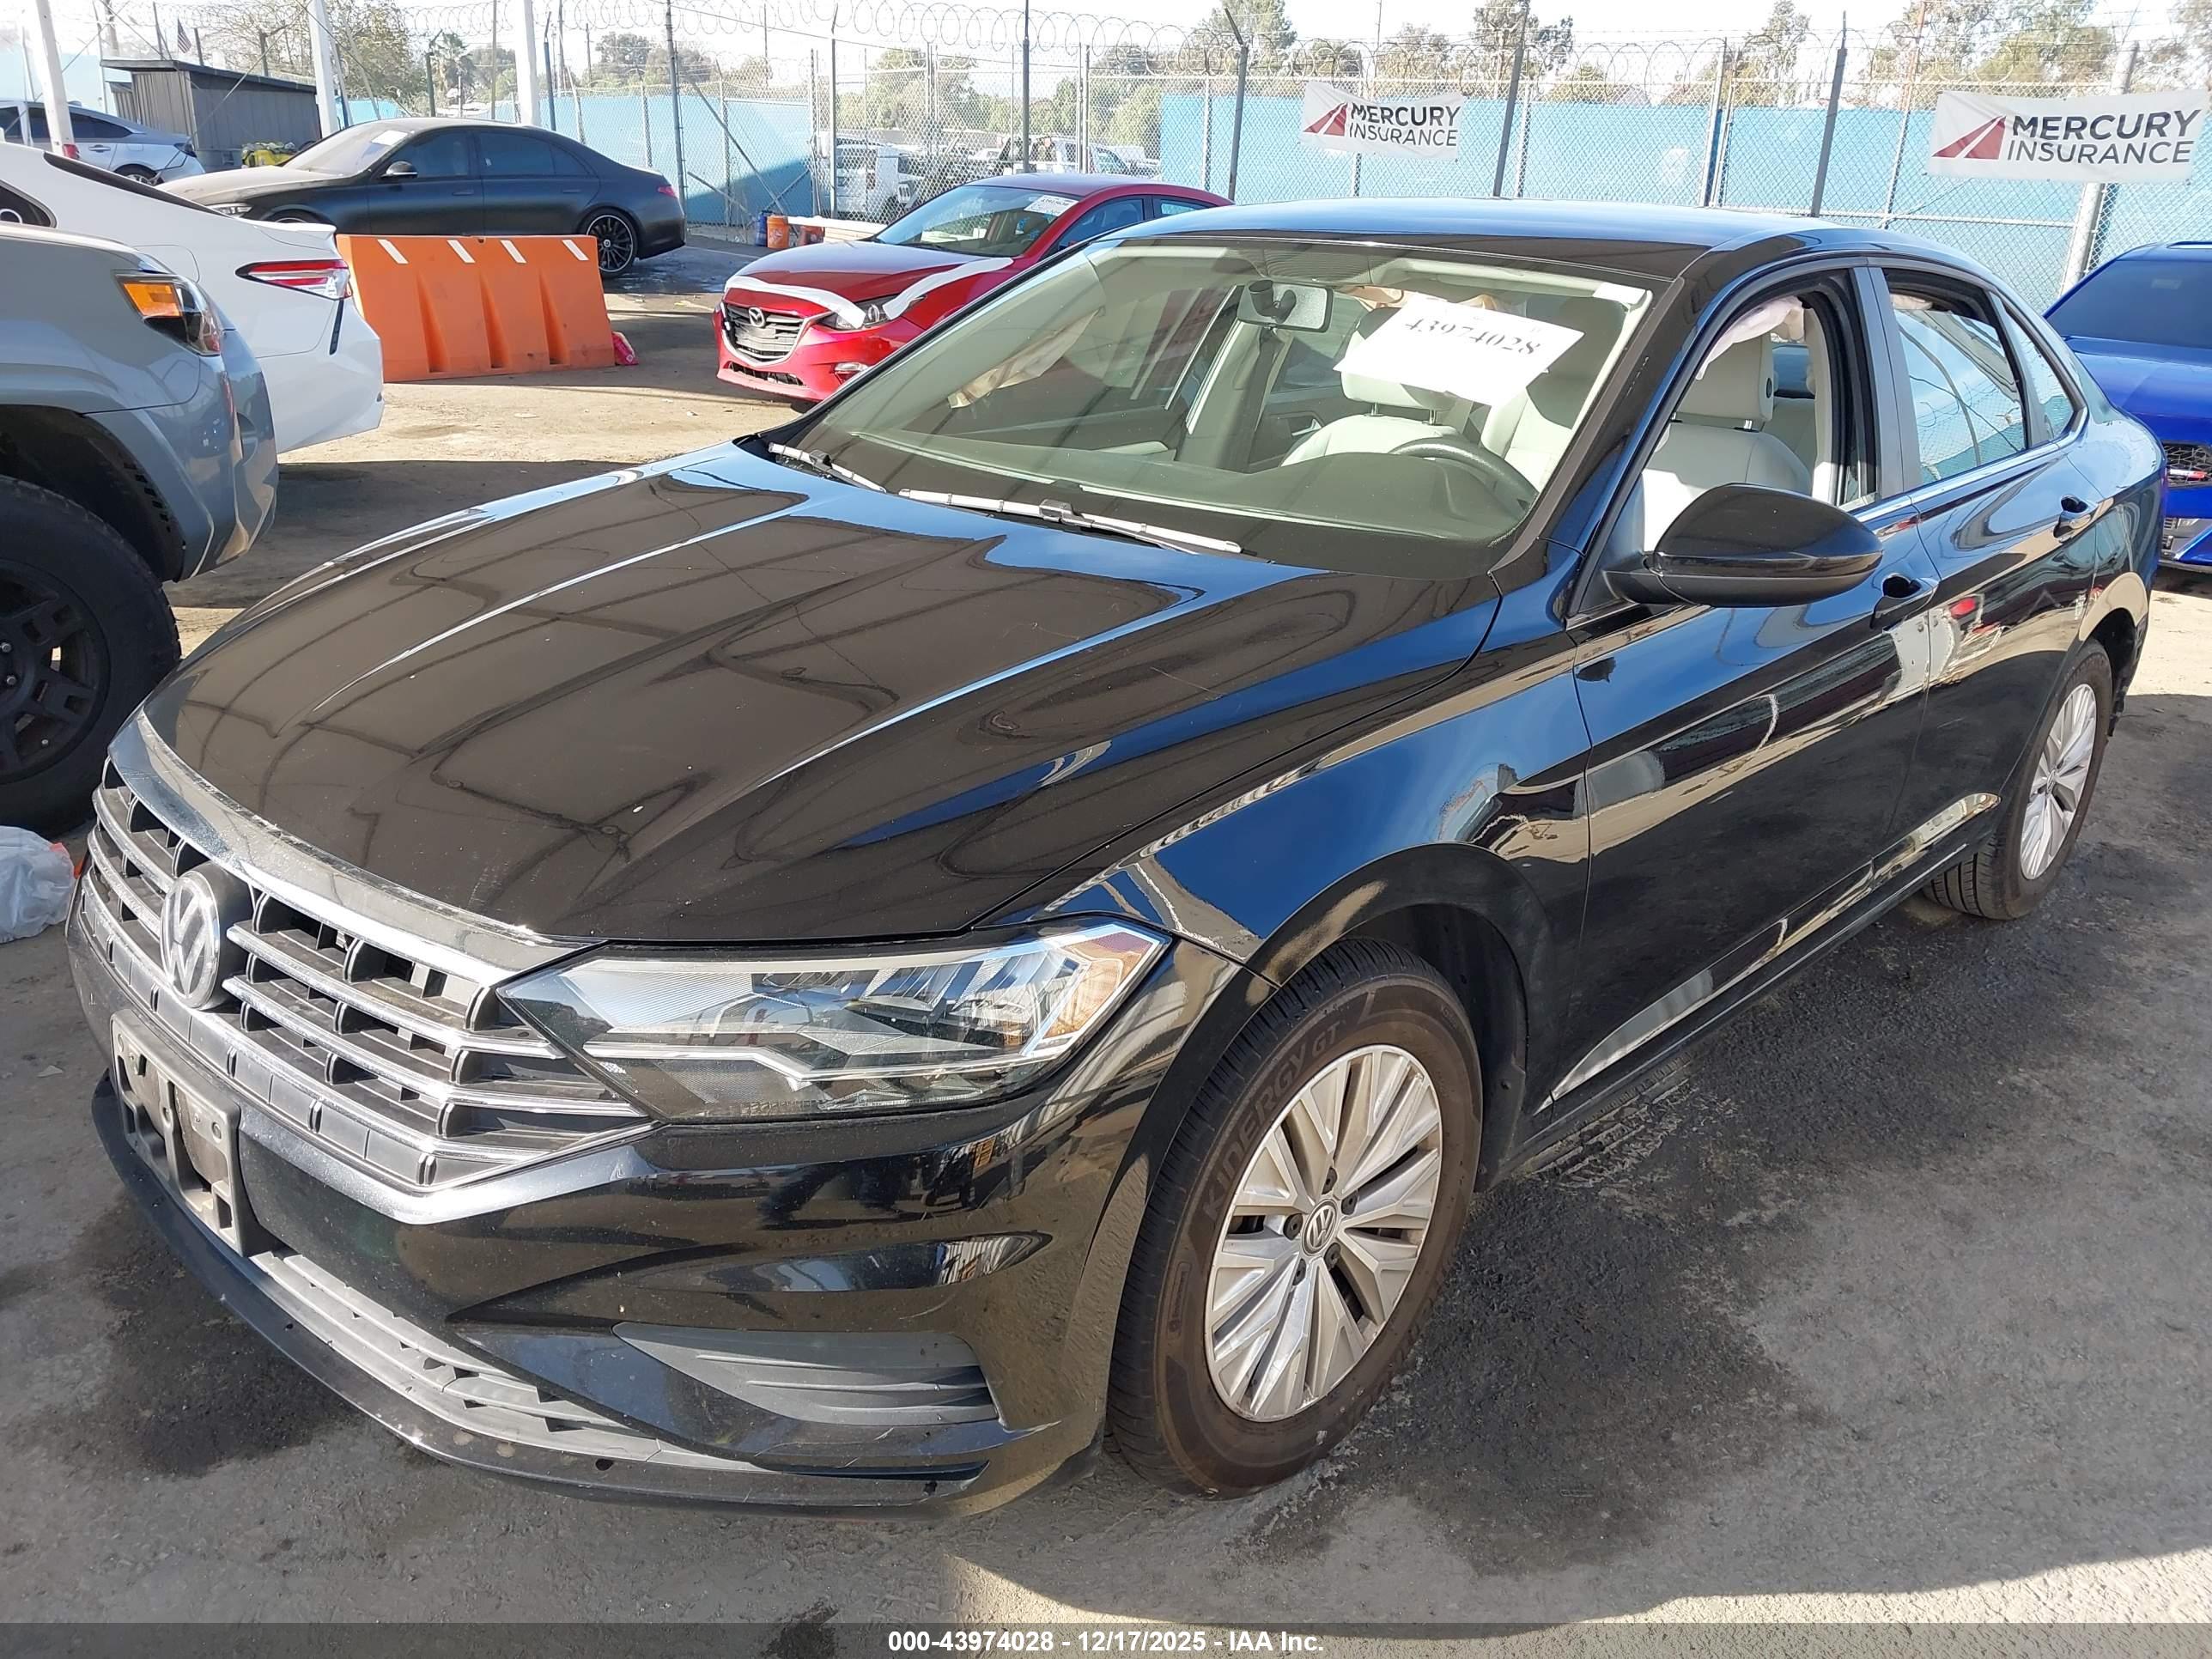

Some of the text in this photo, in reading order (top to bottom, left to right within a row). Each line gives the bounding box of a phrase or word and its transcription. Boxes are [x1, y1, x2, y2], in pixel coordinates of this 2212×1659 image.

[1351, 101, 1462, 127] MERCURY
[2012, 109, 2201, 141] MERCURY
[1349, 122, 1458, 147] INSURANCE
[2007, 140, 2194, 164] INSURANCE
